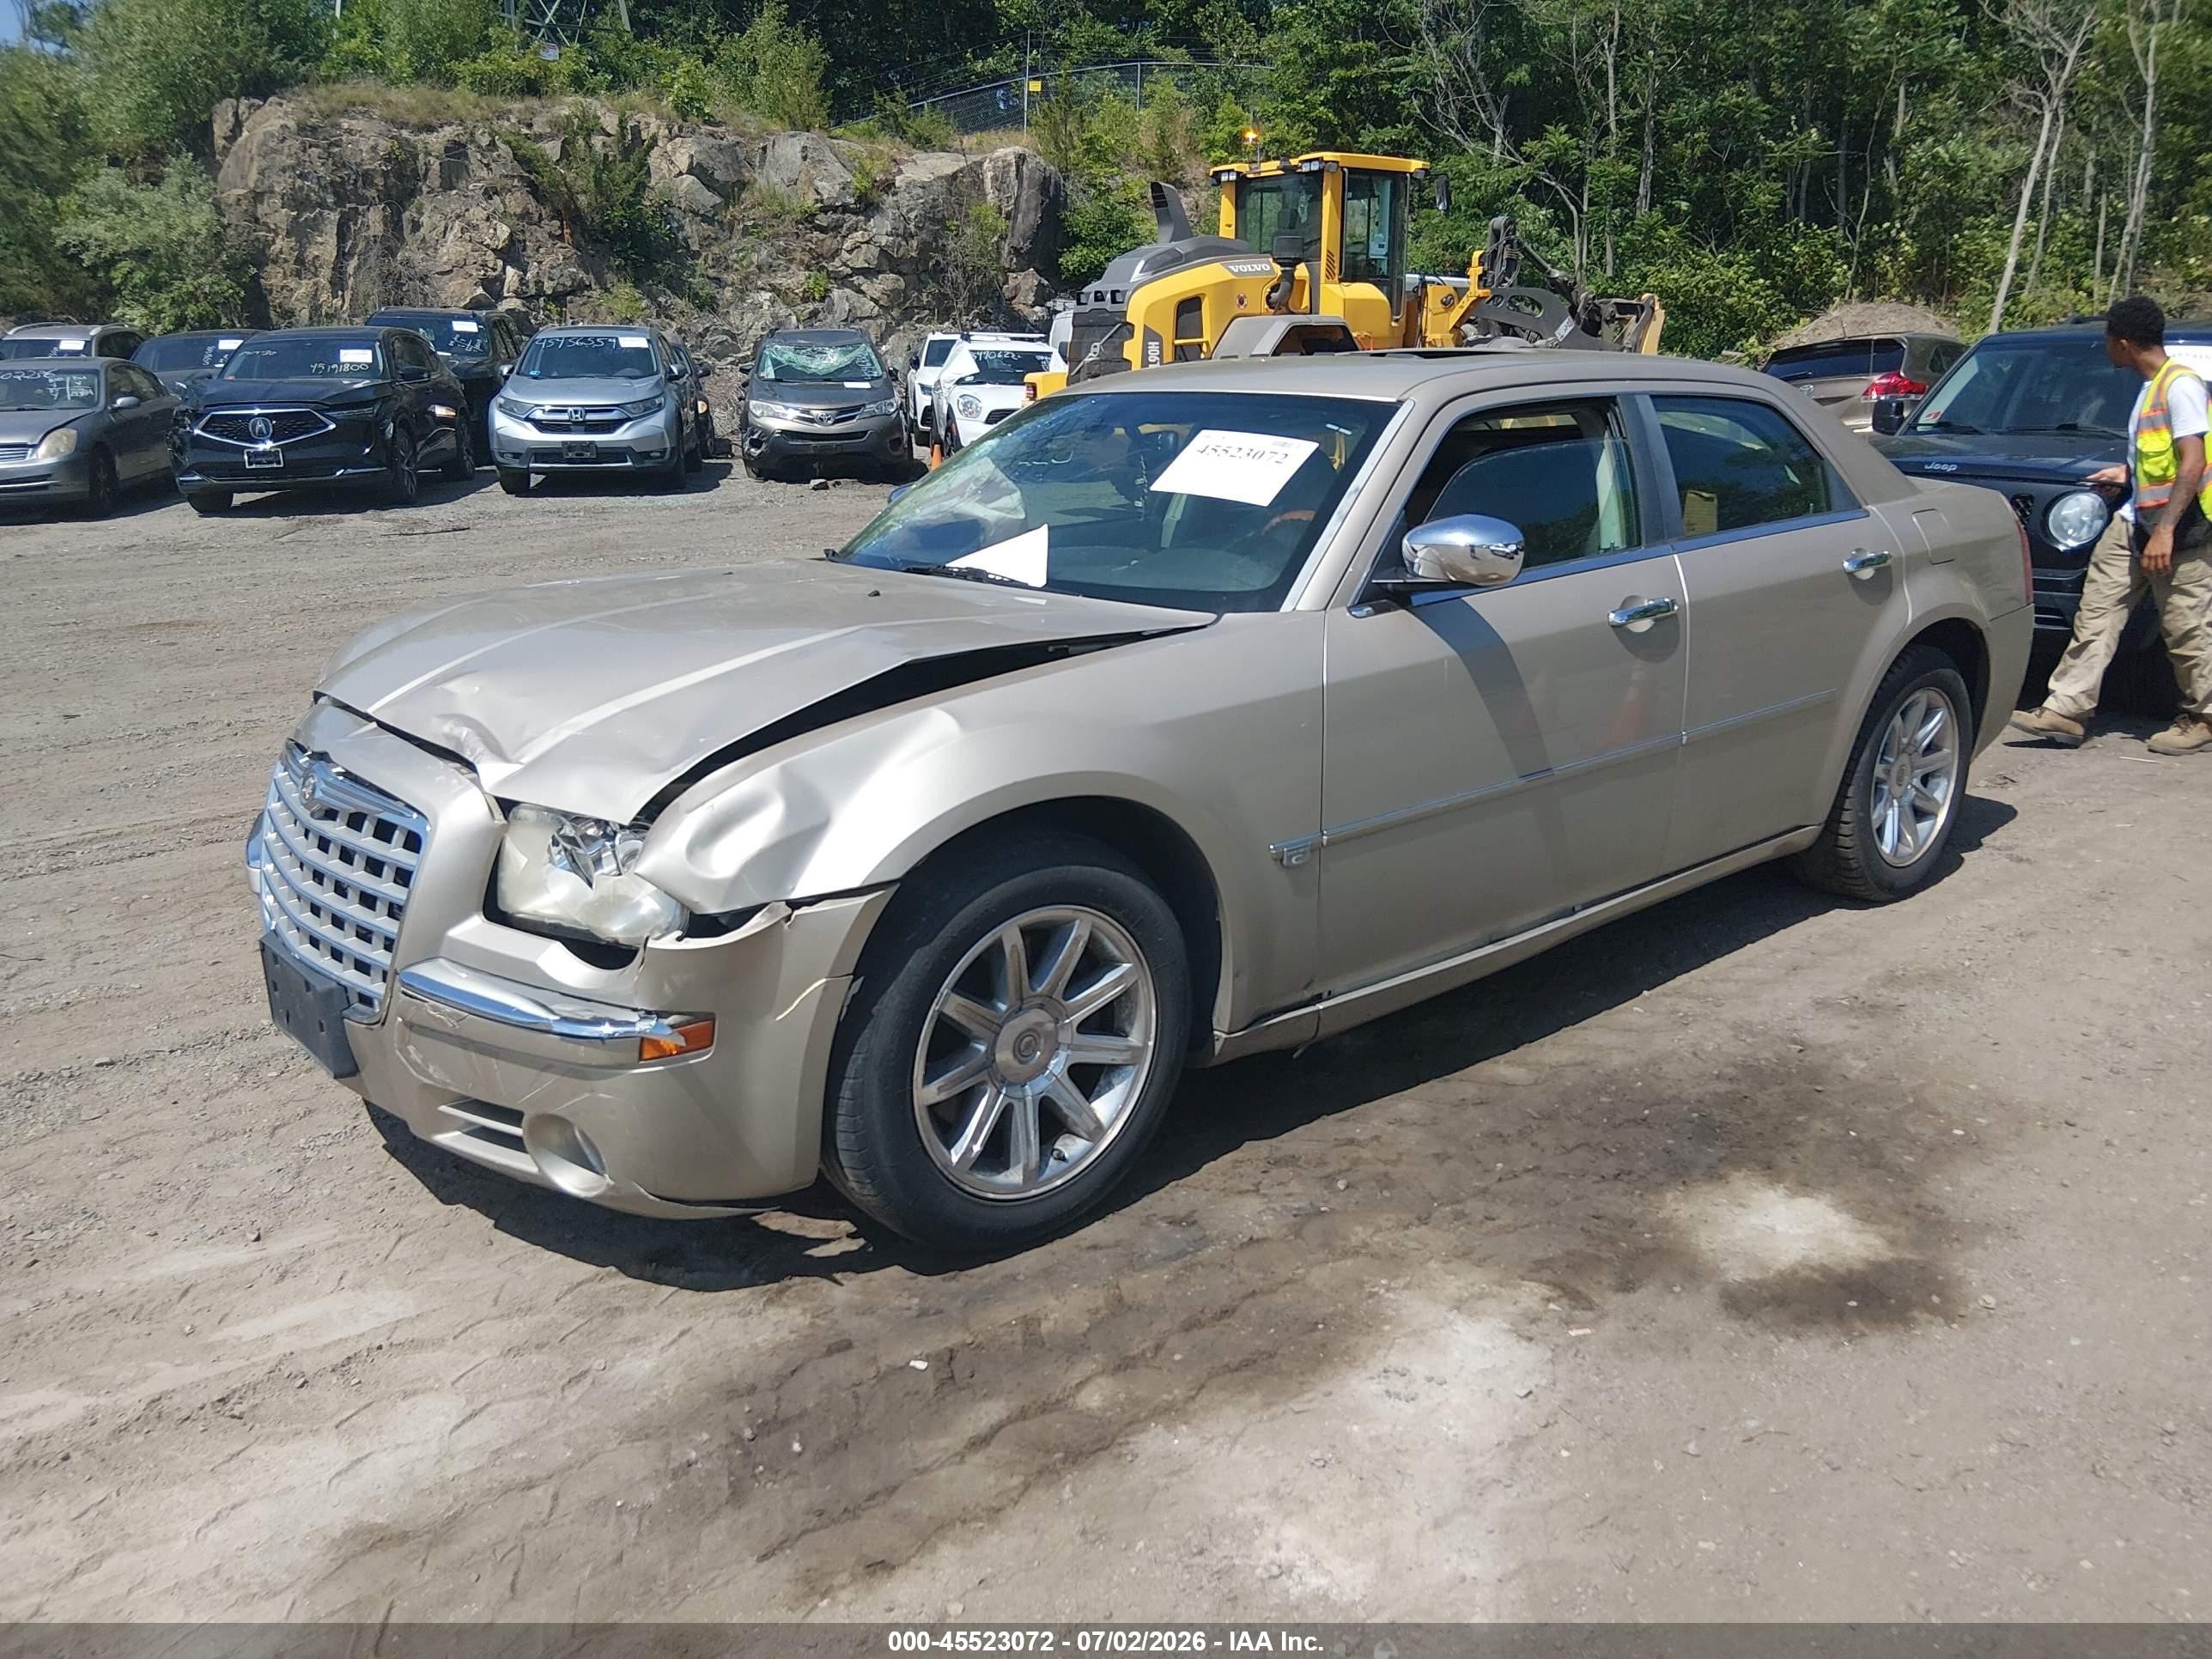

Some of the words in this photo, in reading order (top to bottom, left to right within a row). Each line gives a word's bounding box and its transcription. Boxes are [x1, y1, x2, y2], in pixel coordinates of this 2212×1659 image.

[1229, 263, 1271, 272] VOLVO
[1197, 444, 1289, 465] 45523072
[1924, 461, 1958, 472] Jeep
